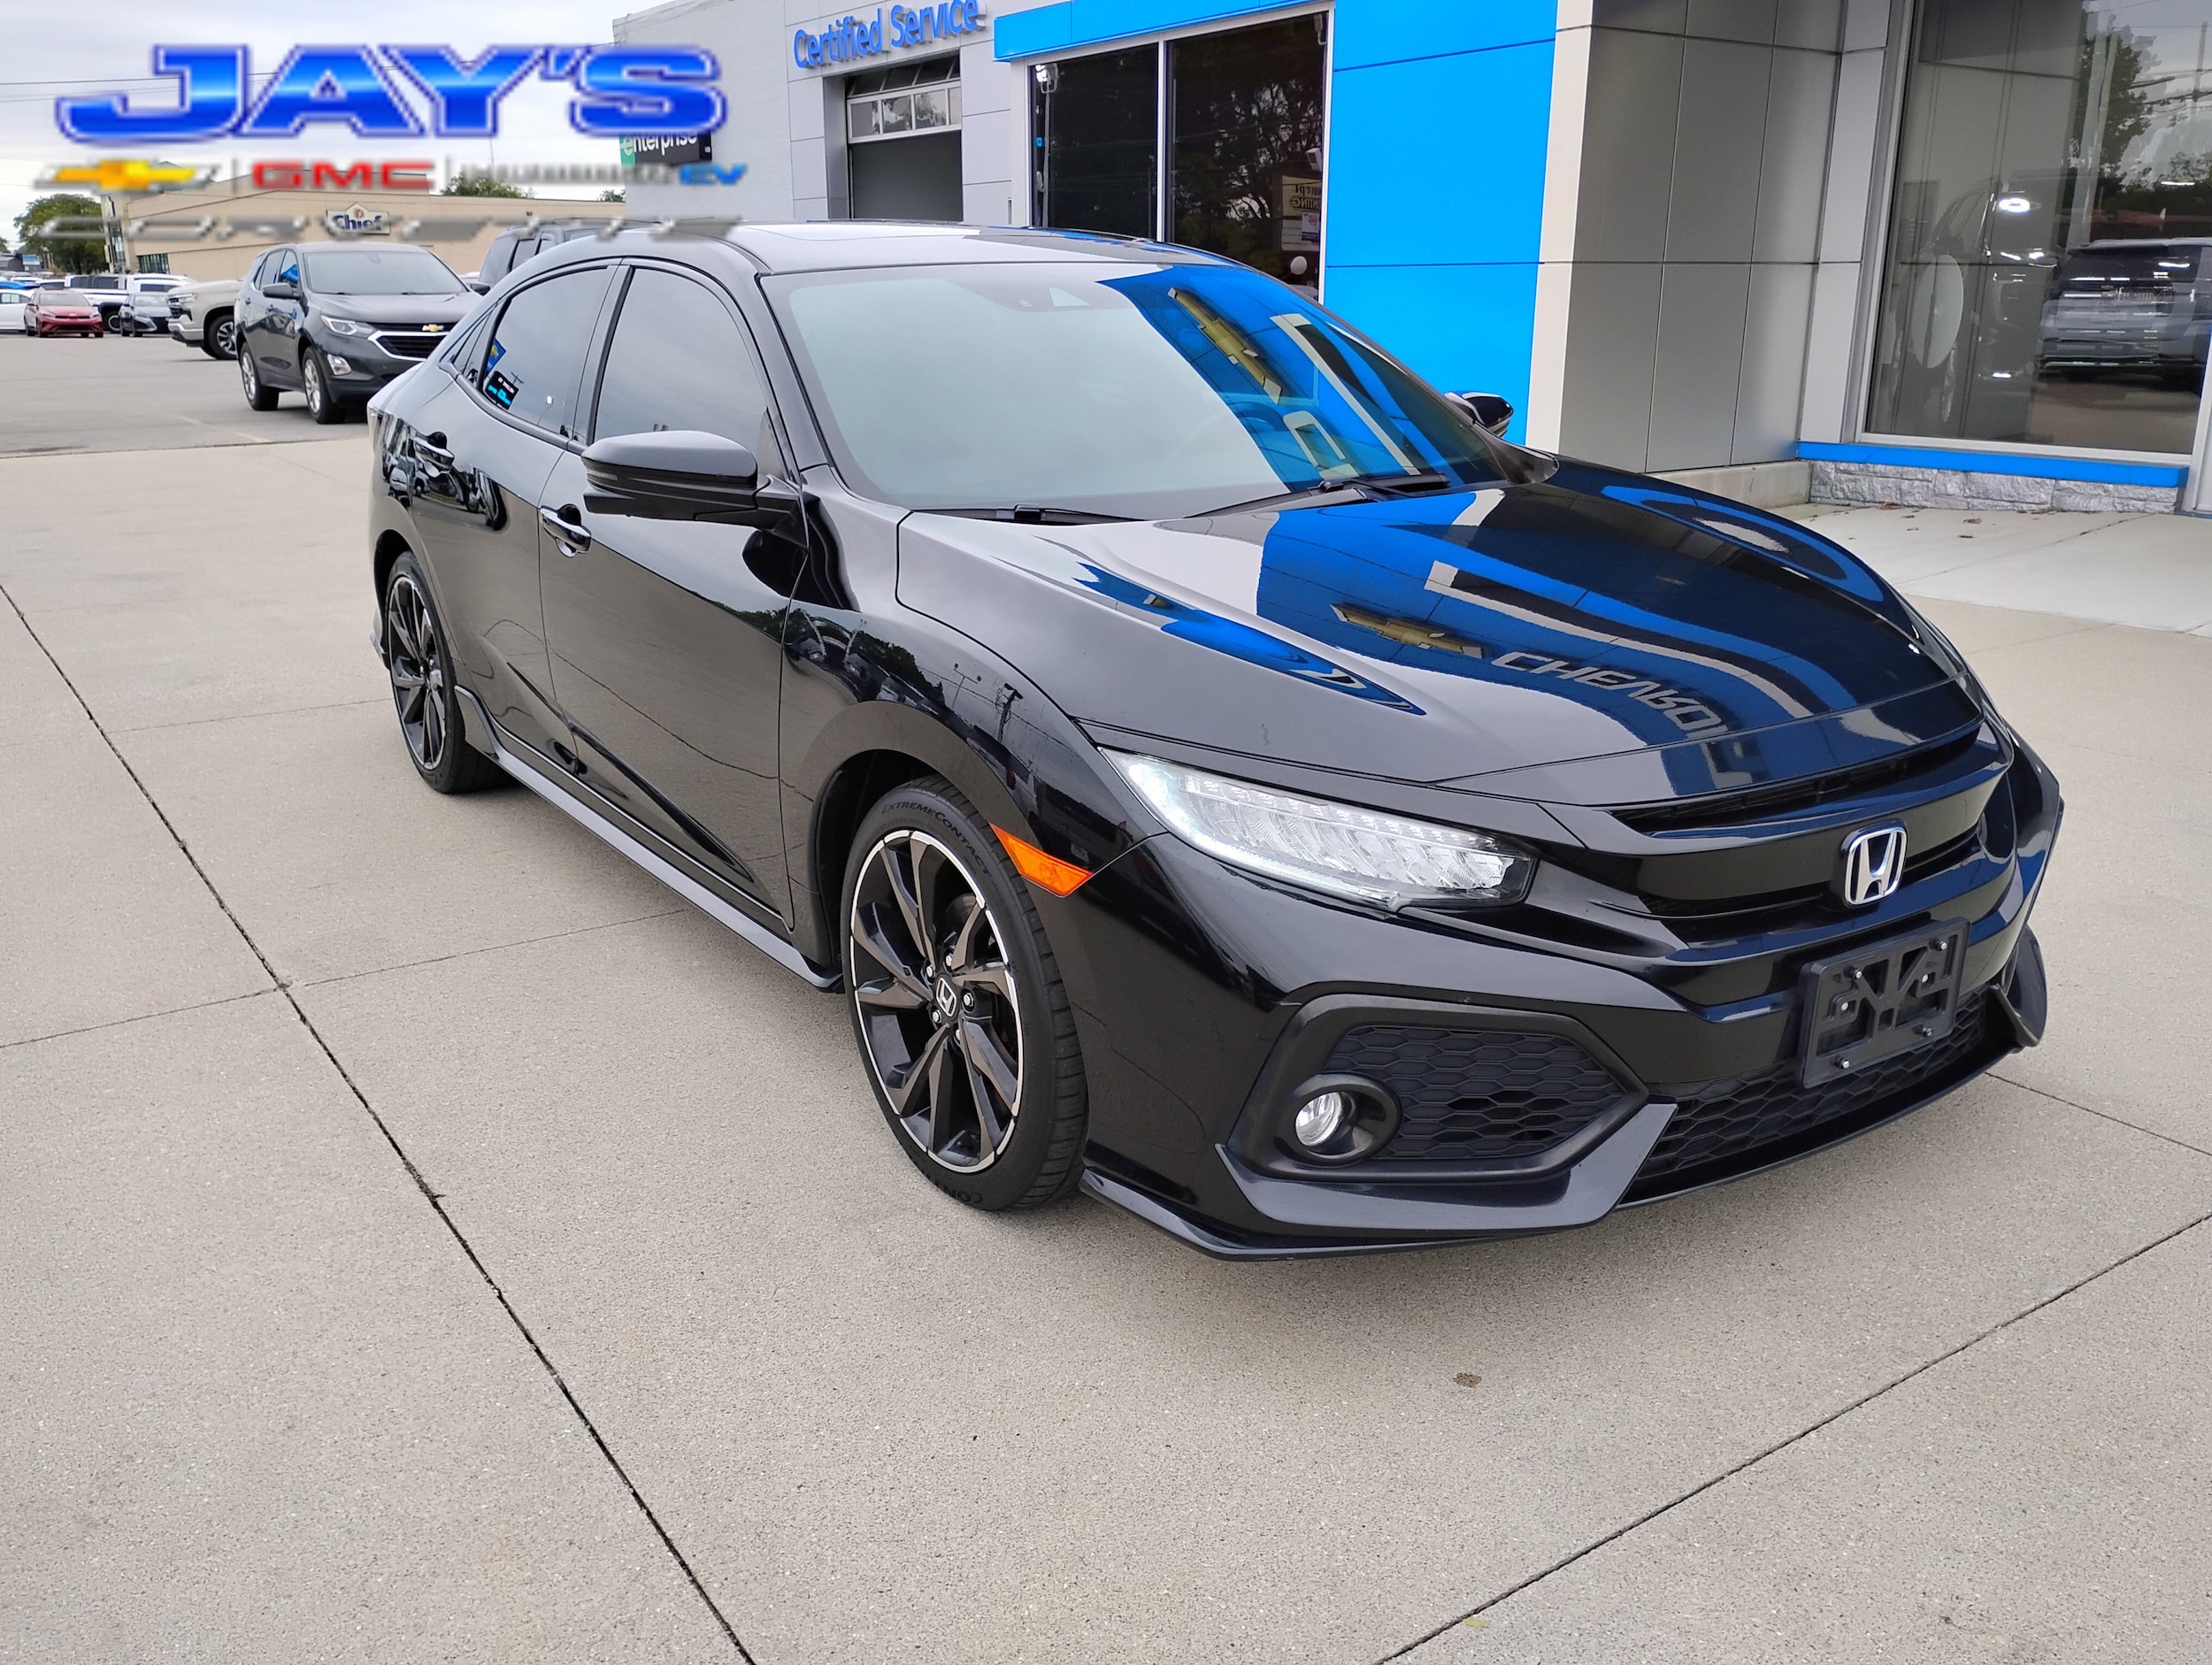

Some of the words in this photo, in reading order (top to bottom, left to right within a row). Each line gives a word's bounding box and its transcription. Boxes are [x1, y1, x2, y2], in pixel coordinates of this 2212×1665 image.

[793, 8, 883, 69] Certified
[890, 0, 979, 48] Service
[332, 214, 382, 231] Chief
